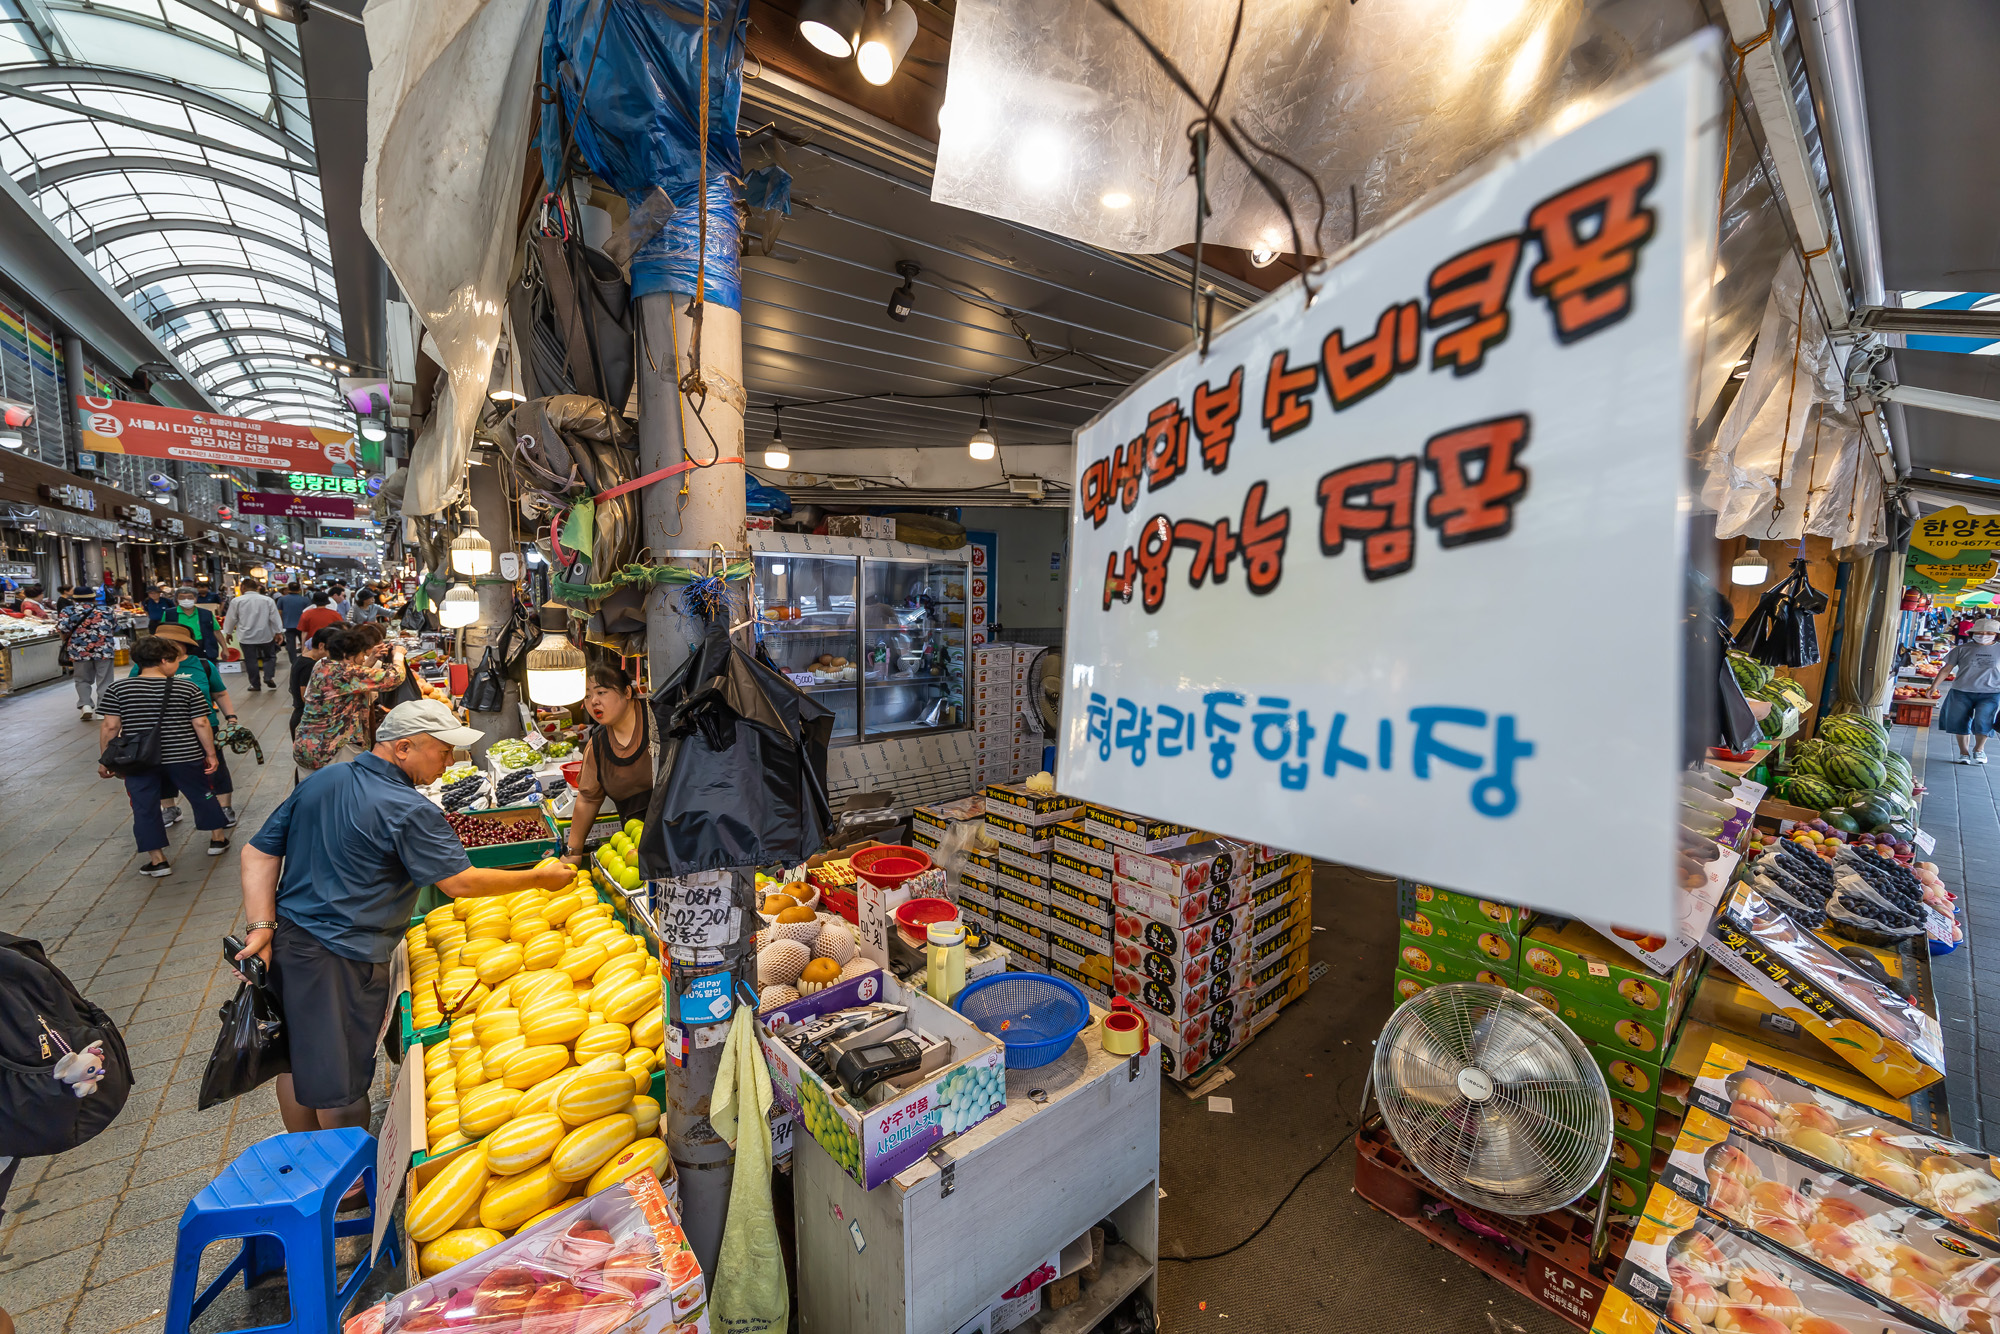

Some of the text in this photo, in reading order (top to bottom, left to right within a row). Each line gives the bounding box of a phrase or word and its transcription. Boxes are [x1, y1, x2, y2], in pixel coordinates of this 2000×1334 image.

[1081, 153, 1660, 529] 민생회복 소비쿠폰
[94, 416, 117, 434] 경
[128, 418, 319, 450] 서울시 디자인 혁신 전통시장 조성
[190, 436, 269, 454] 공모사업 선정
[328, 445, 346, 460] 축
[1103, 412, 1535, 614] 사용가능 점포
[1085, 692, 1537, 818] 청량리종합시장
[664, 923, 708, 944] 정동순
[1722, 930, 1789, 980] 햇사레
[704, 988, 721, 997] 할인
[706, 980, 721, 988] Pay
[879, 1096, 928, 1134] 상주 명품
[875, 1110, 934, 1158] 샤인머스켓
[1544, 1266, 1593, 1299] KPP
